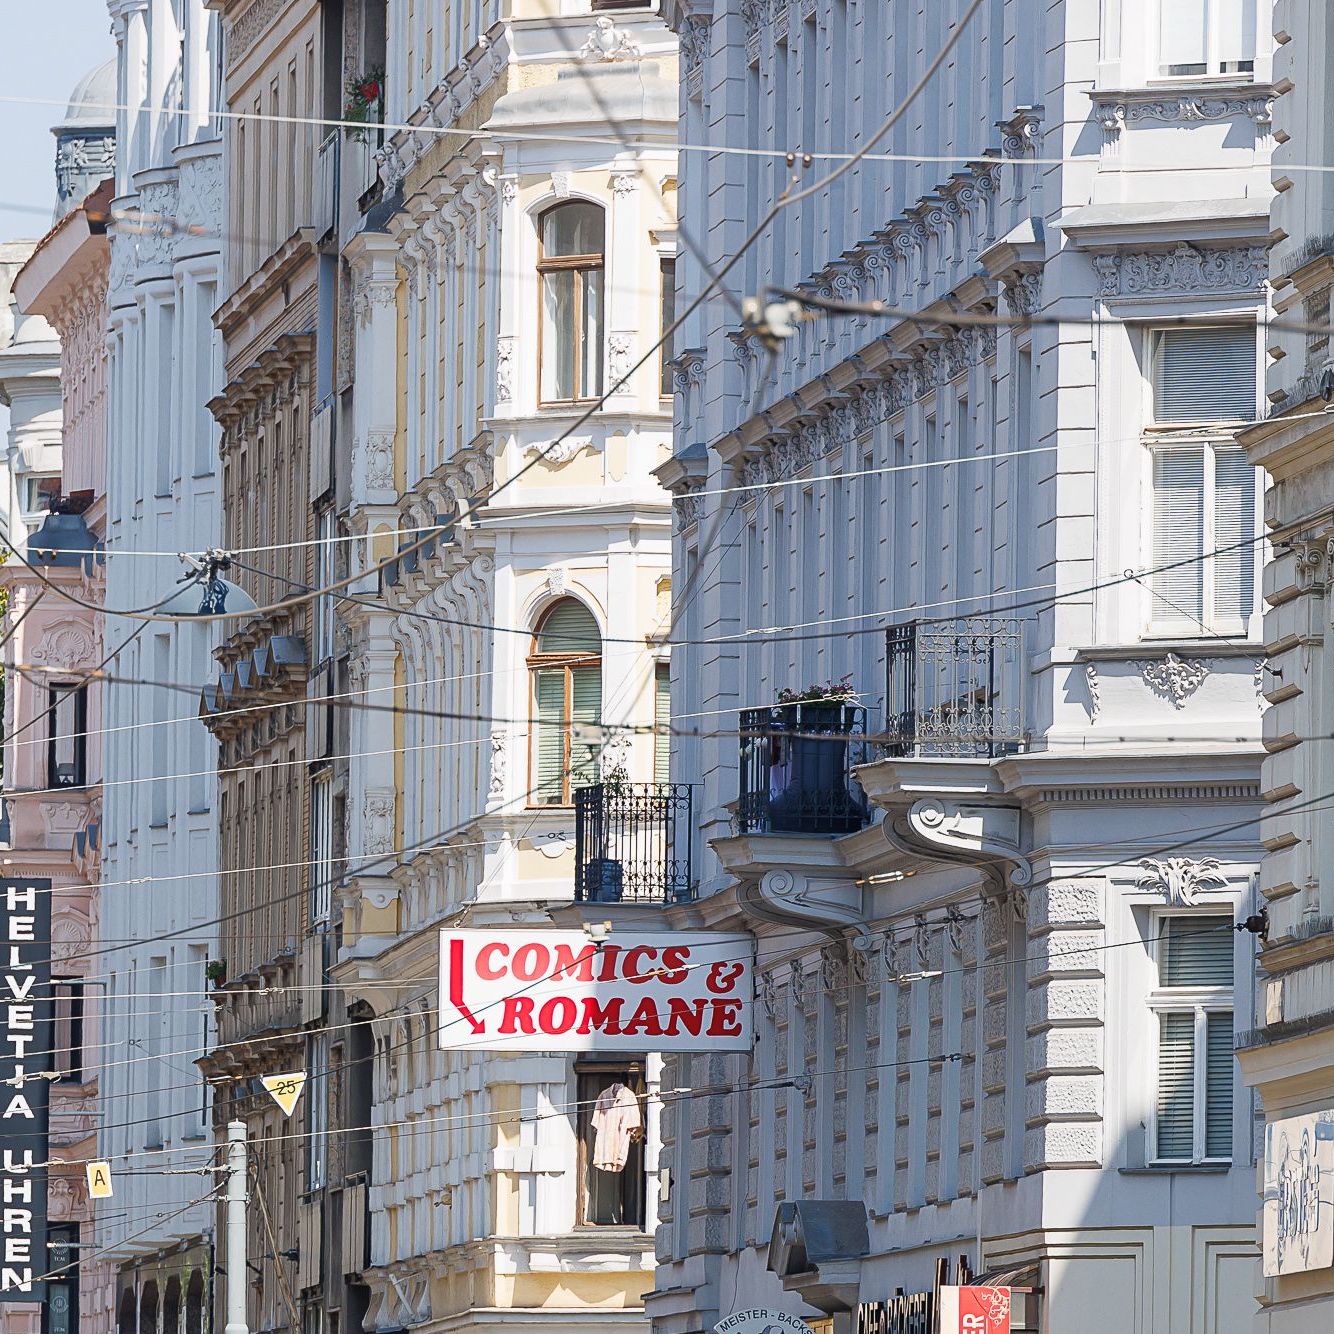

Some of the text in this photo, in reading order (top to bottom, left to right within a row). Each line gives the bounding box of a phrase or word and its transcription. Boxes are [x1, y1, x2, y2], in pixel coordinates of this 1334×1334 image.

[475, 942, 744, 994] COMICS &
[497, 997, 743, 1036] ROMANE
[1, 886, 37, 1292] HELVETIA UHREN
[275, 1079, 297, 1096] 25
[93, 1169, 106, 1187] A
[719, 1309, 768, 1333] MEISTER
